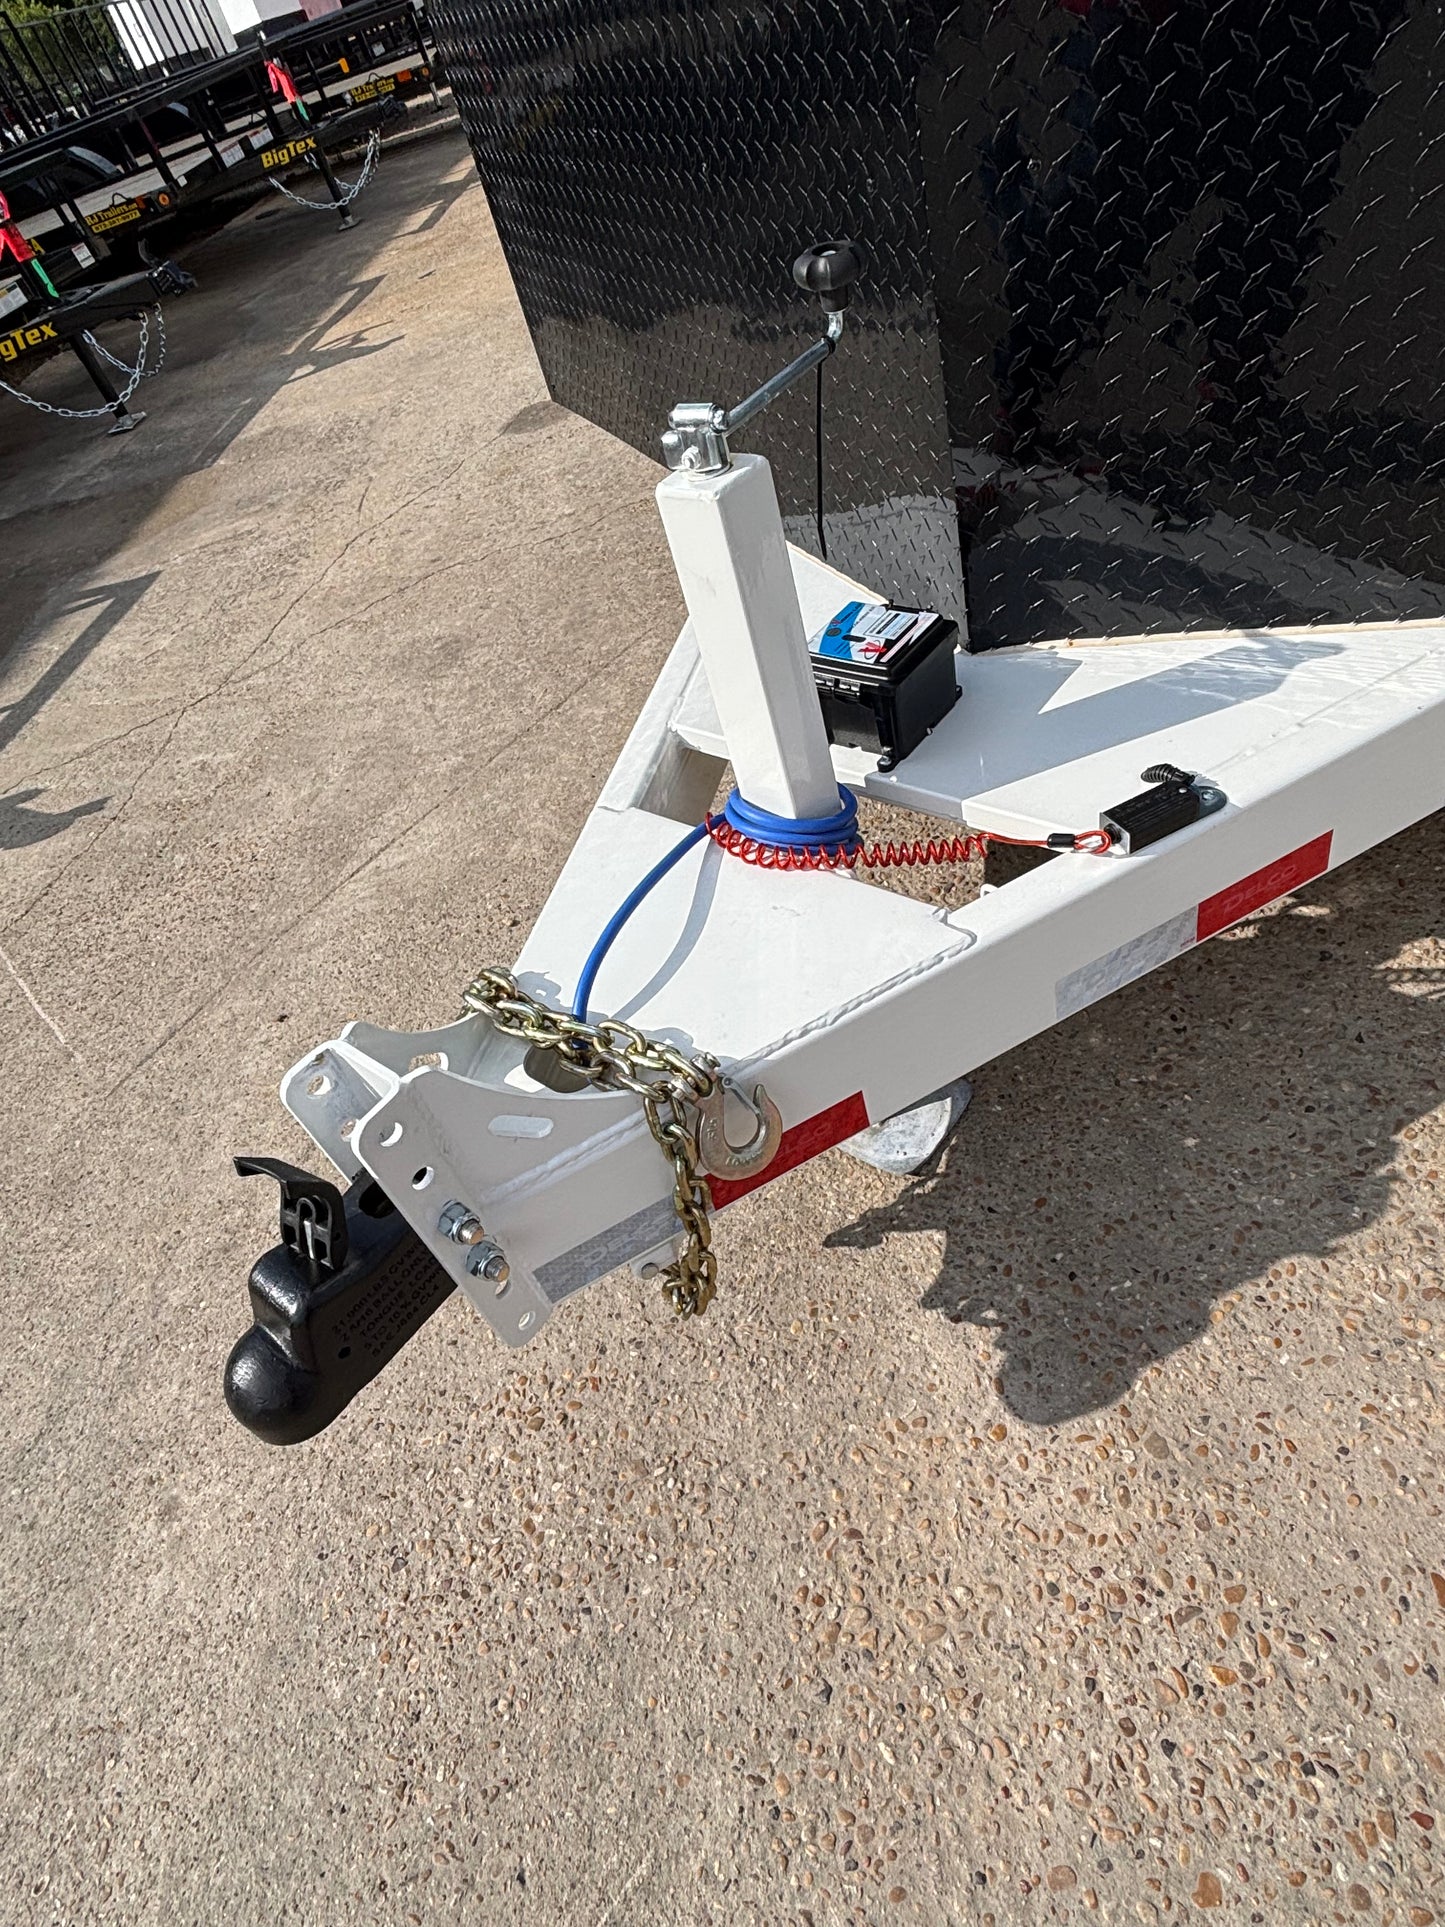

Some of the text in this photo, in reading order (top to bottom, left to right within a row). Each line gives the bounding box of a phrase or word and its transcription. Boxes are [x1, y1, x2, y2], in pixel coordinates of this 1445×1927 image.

[261, 136, 317, 168] BigTex
[0, 322, 58, 362] gTex
[373, 1278, 402, 1307] BALL
[360, 1288, 406, 1336] TONGUE
[372, 1325, 388, 1341] TO
